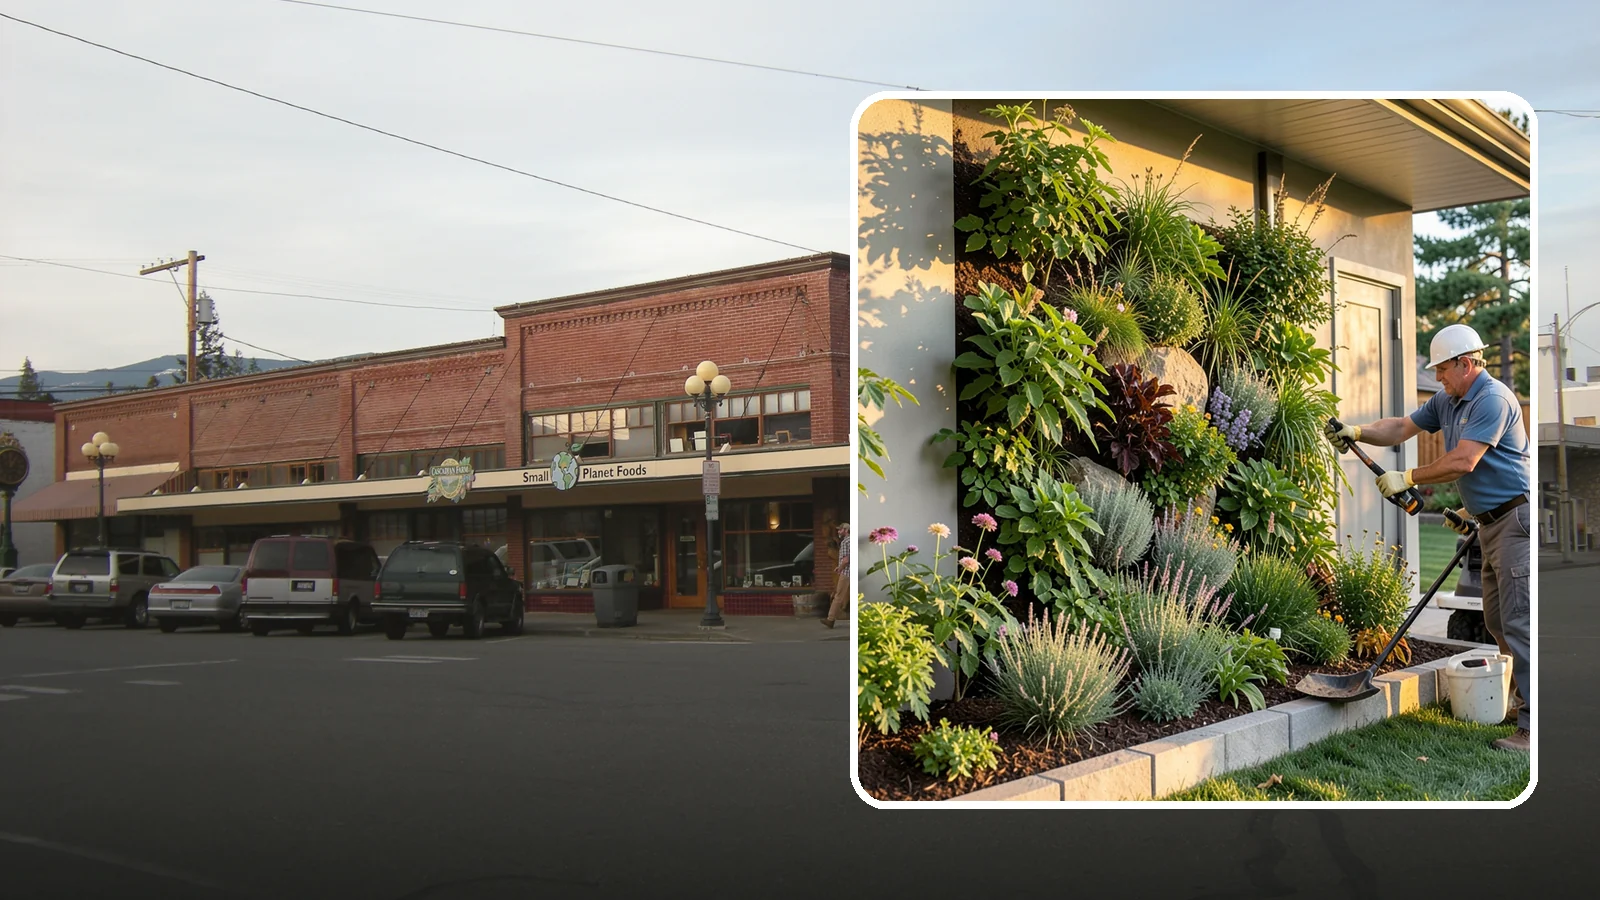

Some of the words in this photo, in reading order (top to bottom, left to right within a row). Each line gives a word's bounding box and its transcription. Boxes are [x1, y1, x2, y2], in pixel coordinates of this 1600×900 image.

[431, 467, 456, 476] CASCADIAN
[523, 471, 549, 483] Small
[583, 467, 614, 479] Planet
[617, 464, 647, 477] Foods
